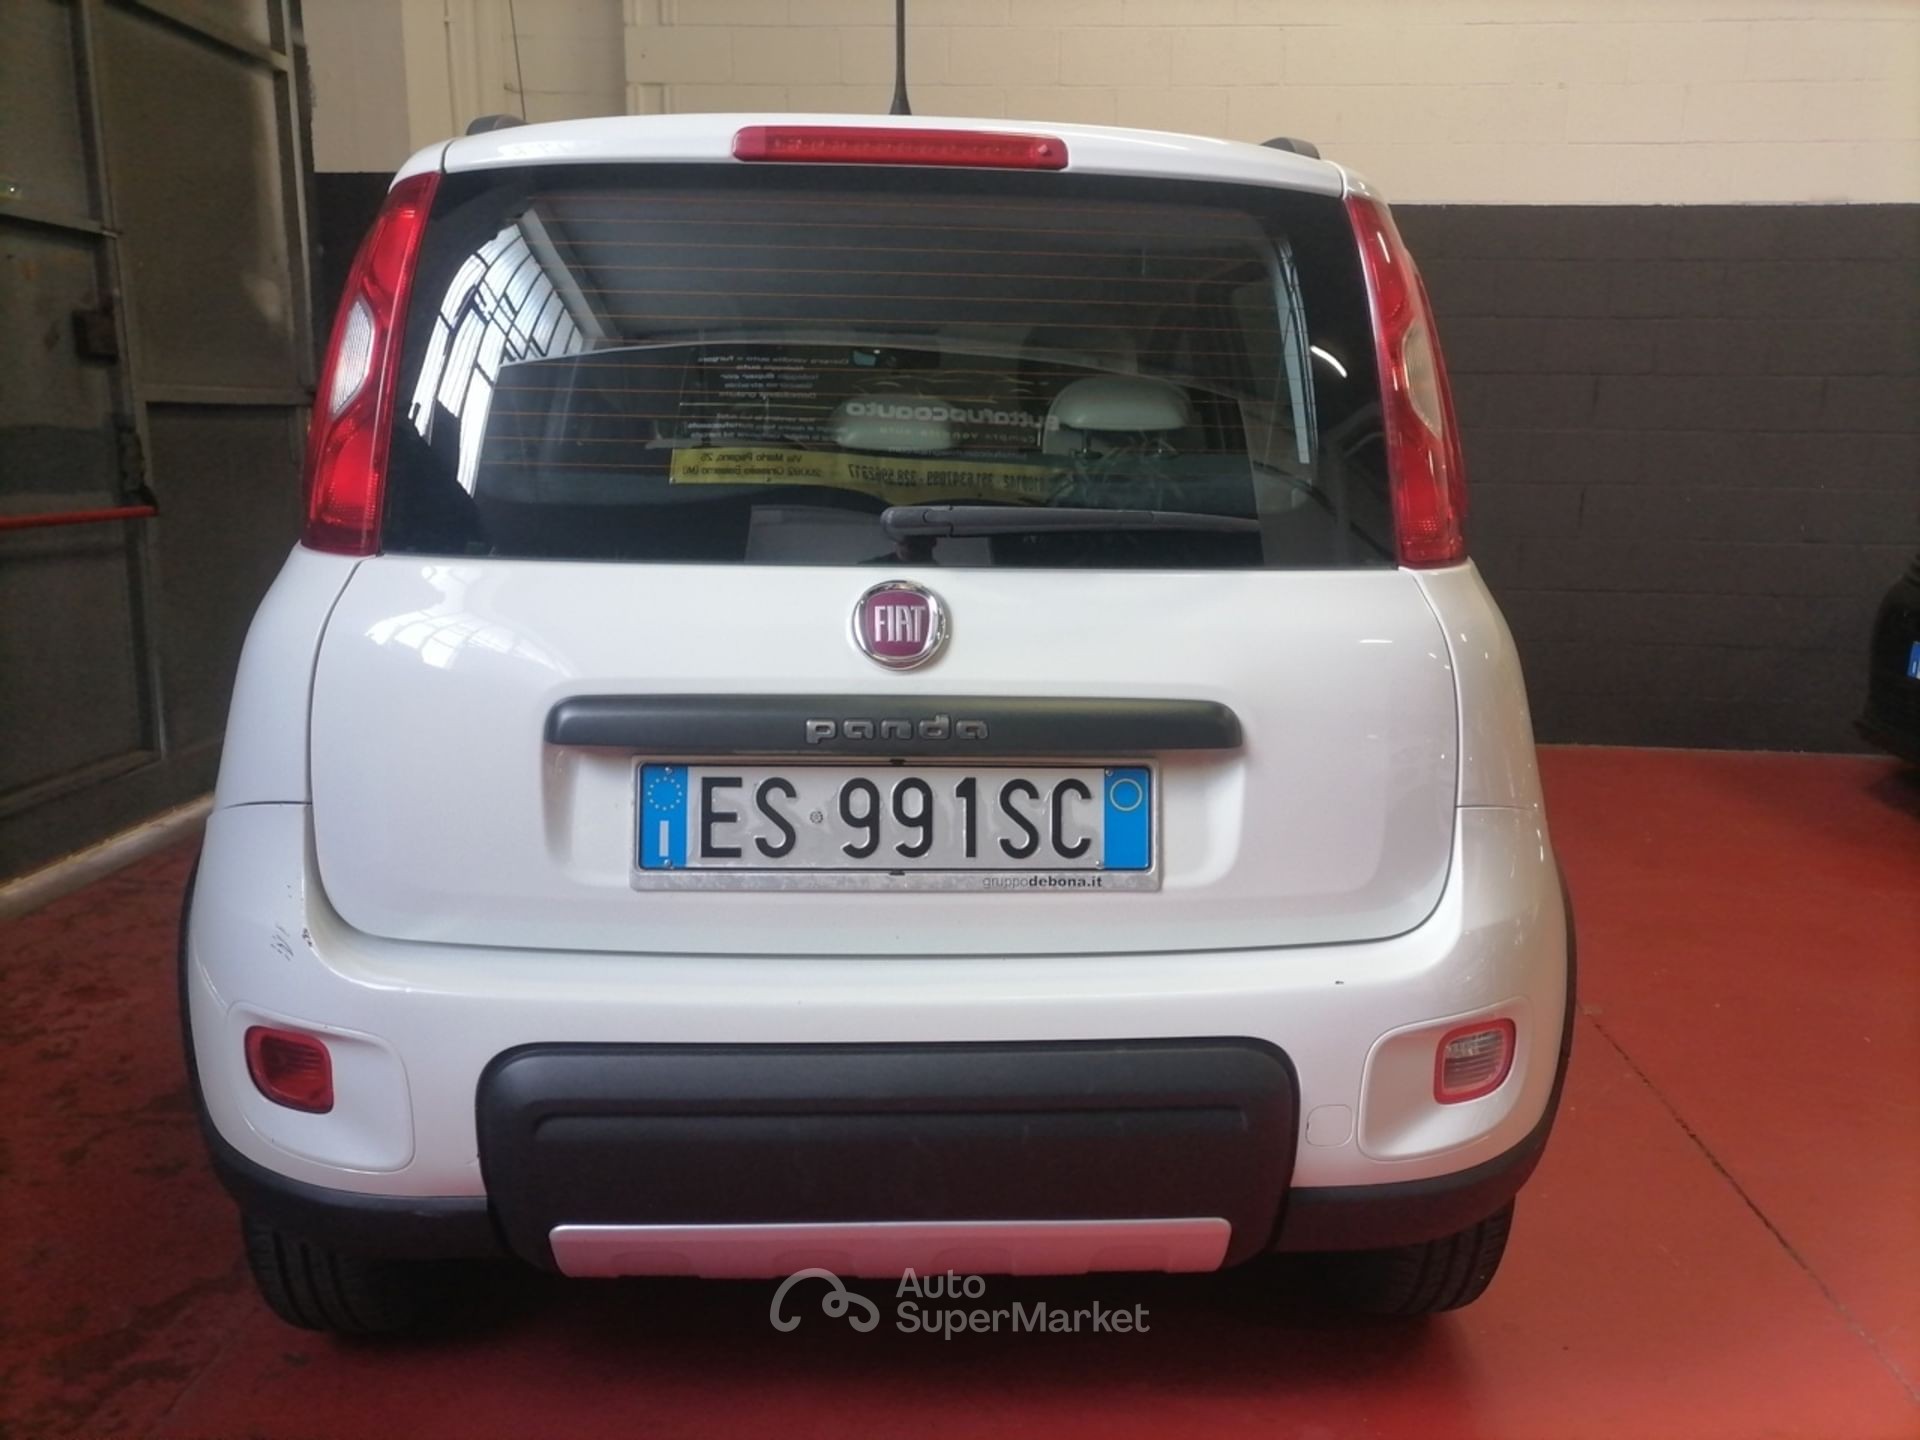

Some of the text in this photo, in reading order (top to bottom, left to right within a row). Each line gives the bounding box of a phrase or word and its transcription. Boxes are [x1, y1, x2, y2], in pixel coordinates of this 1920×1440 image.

[873, 604, 926, 643] FIAT
[805, 714, 990, 744] panda
[700, 776, 1093, 860] ES 991SC
[982, 875, 1103, 889] gruppodebona.it
